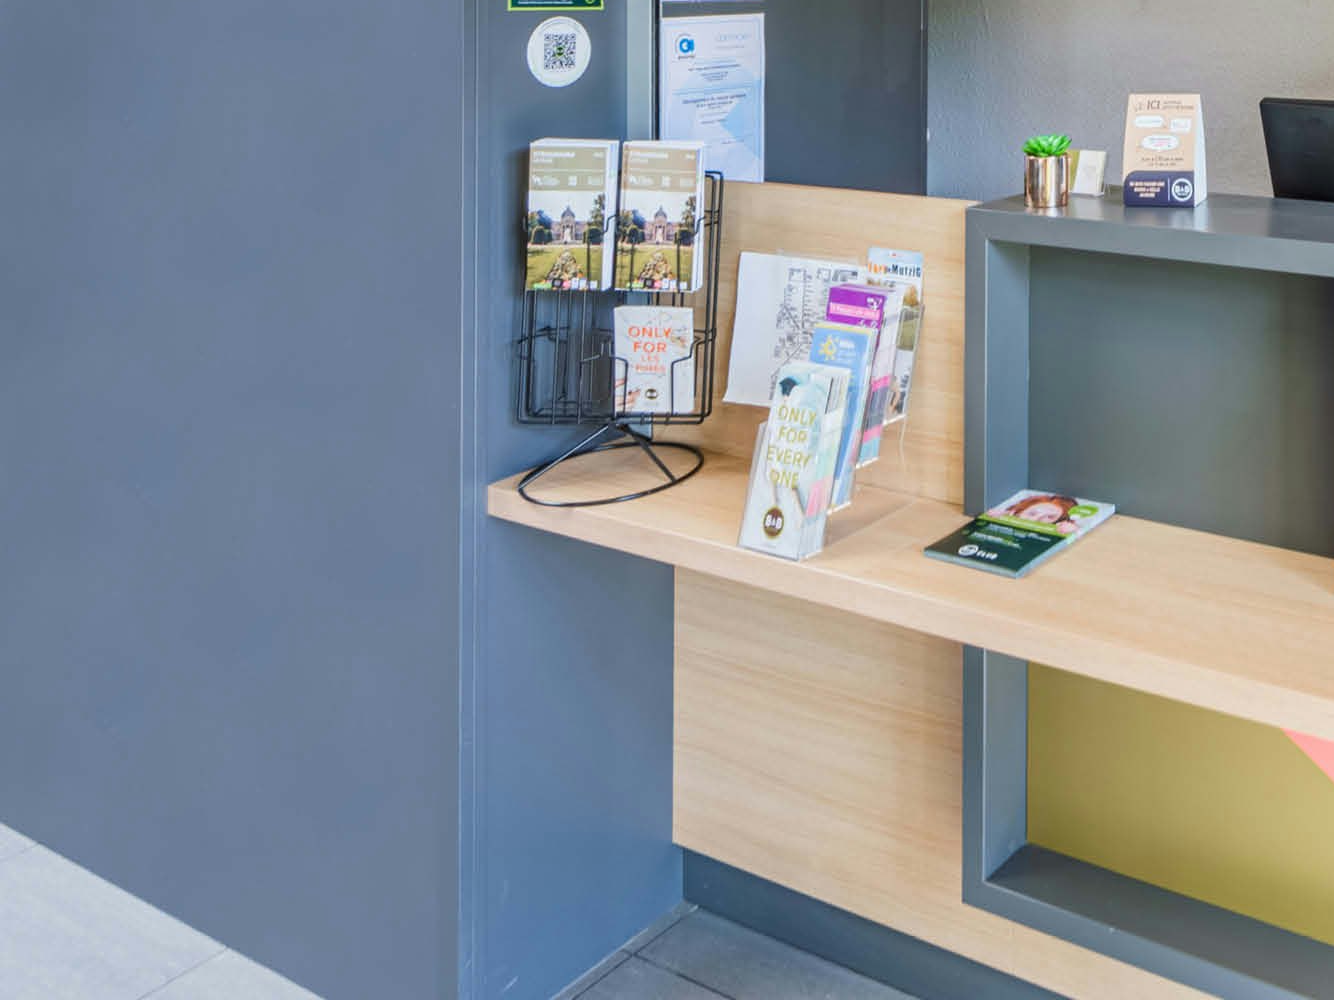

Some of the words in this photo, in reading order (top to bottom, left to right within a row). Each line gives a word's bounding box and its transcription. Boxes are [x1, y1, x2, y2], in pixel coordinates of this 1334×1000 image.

[628, 326, 672, 337] ONLY
[633, 341, 667, 352] FOR
[778, 405, 817, 425] ONLY
[778, 425, 807, 443] FOR
[767, 446, 813, 468] EVERY
[770, 469, 799, 488] ONE
[765, 514, 782, 529] B&B
